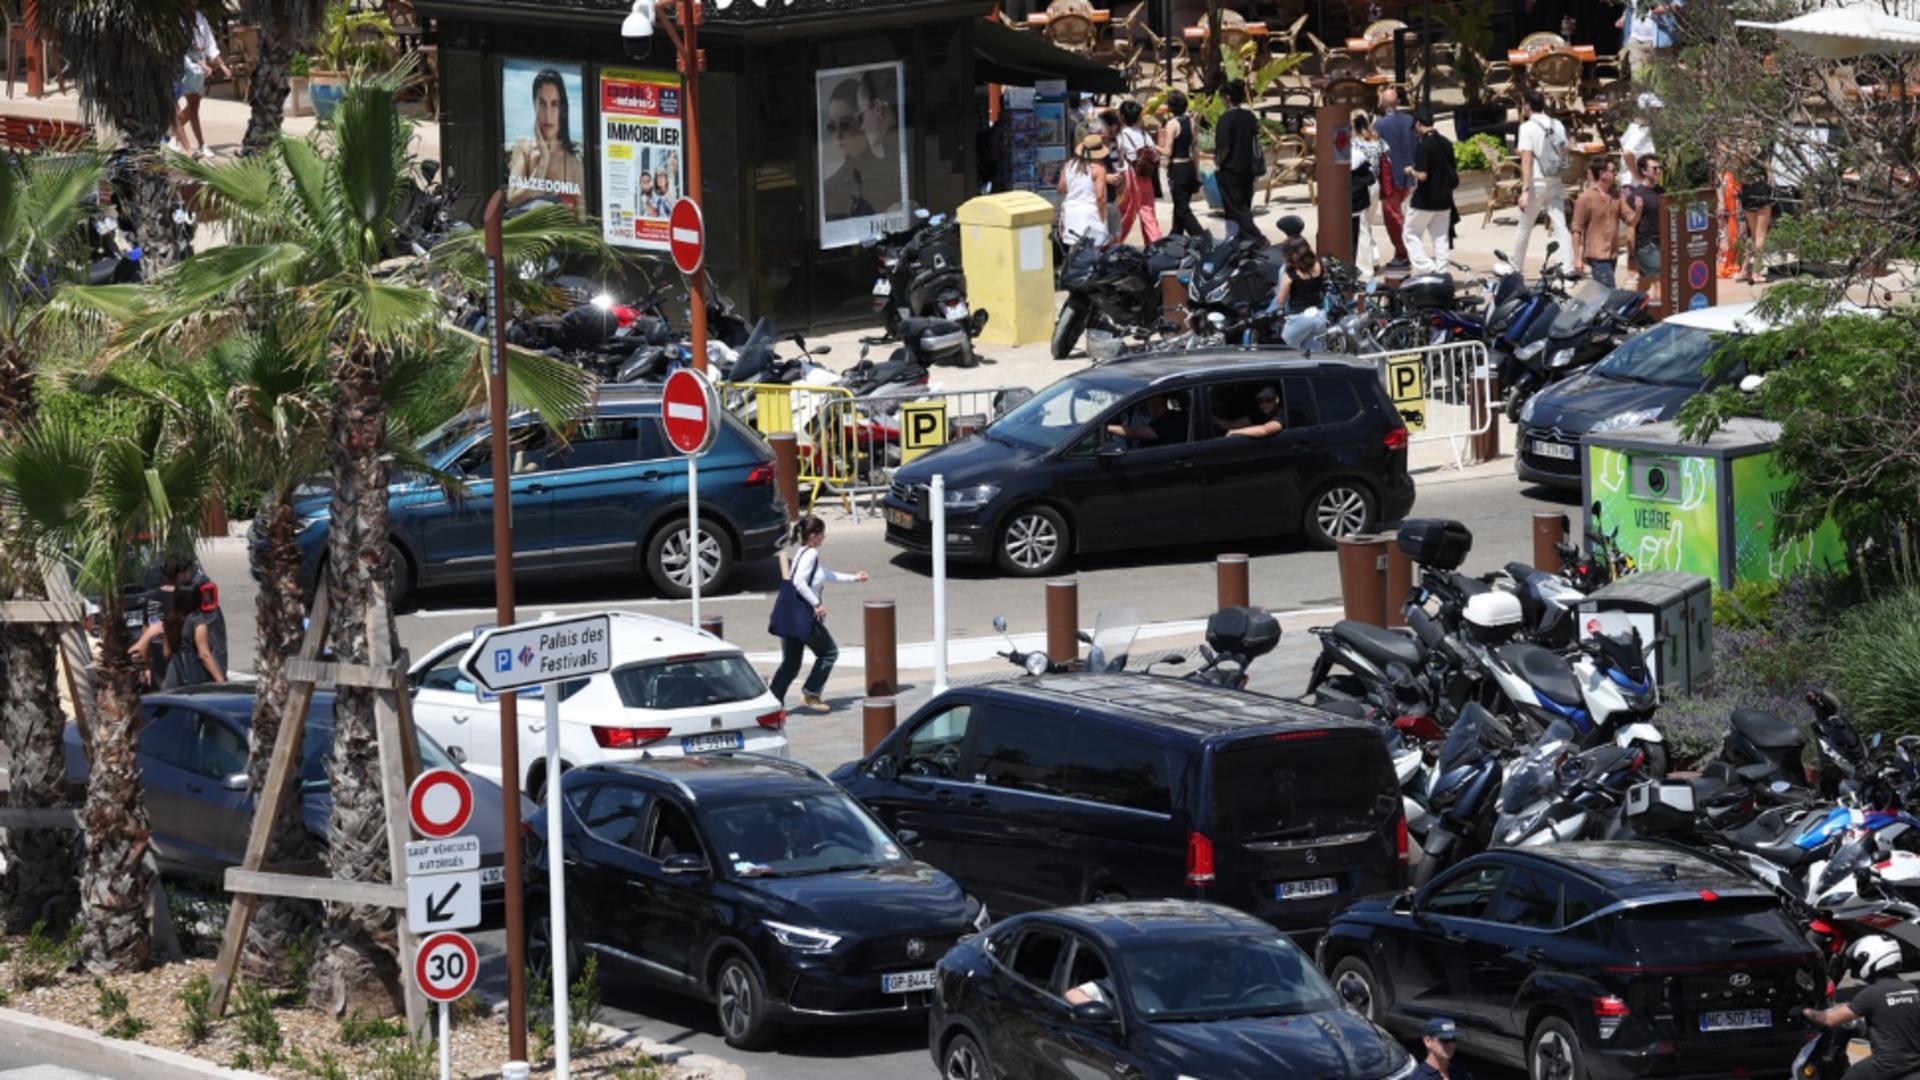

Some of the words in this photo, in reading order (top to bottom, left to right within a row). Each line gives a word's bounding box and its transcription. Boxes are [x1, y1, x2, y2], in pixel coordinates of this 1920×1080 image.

[607, 122, 680, 146] IMMOBILIER
[508, 175, 581, 195] CALZEDONIA
[1397, 367, 1415, 397] P
[914, 413, 937, 444] P
[1634, 508, 1671, 531] VERRE
[539, 632, 578, 650] Palais
[581, 627, 604, 645] des
[497, 652, 509, 671] P
[539, 649, 598, 673] Festivals
[408, 847, 429, 858] SAUF
[433, 840, 478, 855] VÉHICULES
[418, 855, 464, 870] AUTORISÉS
[429, 952, 465, 981] 30
